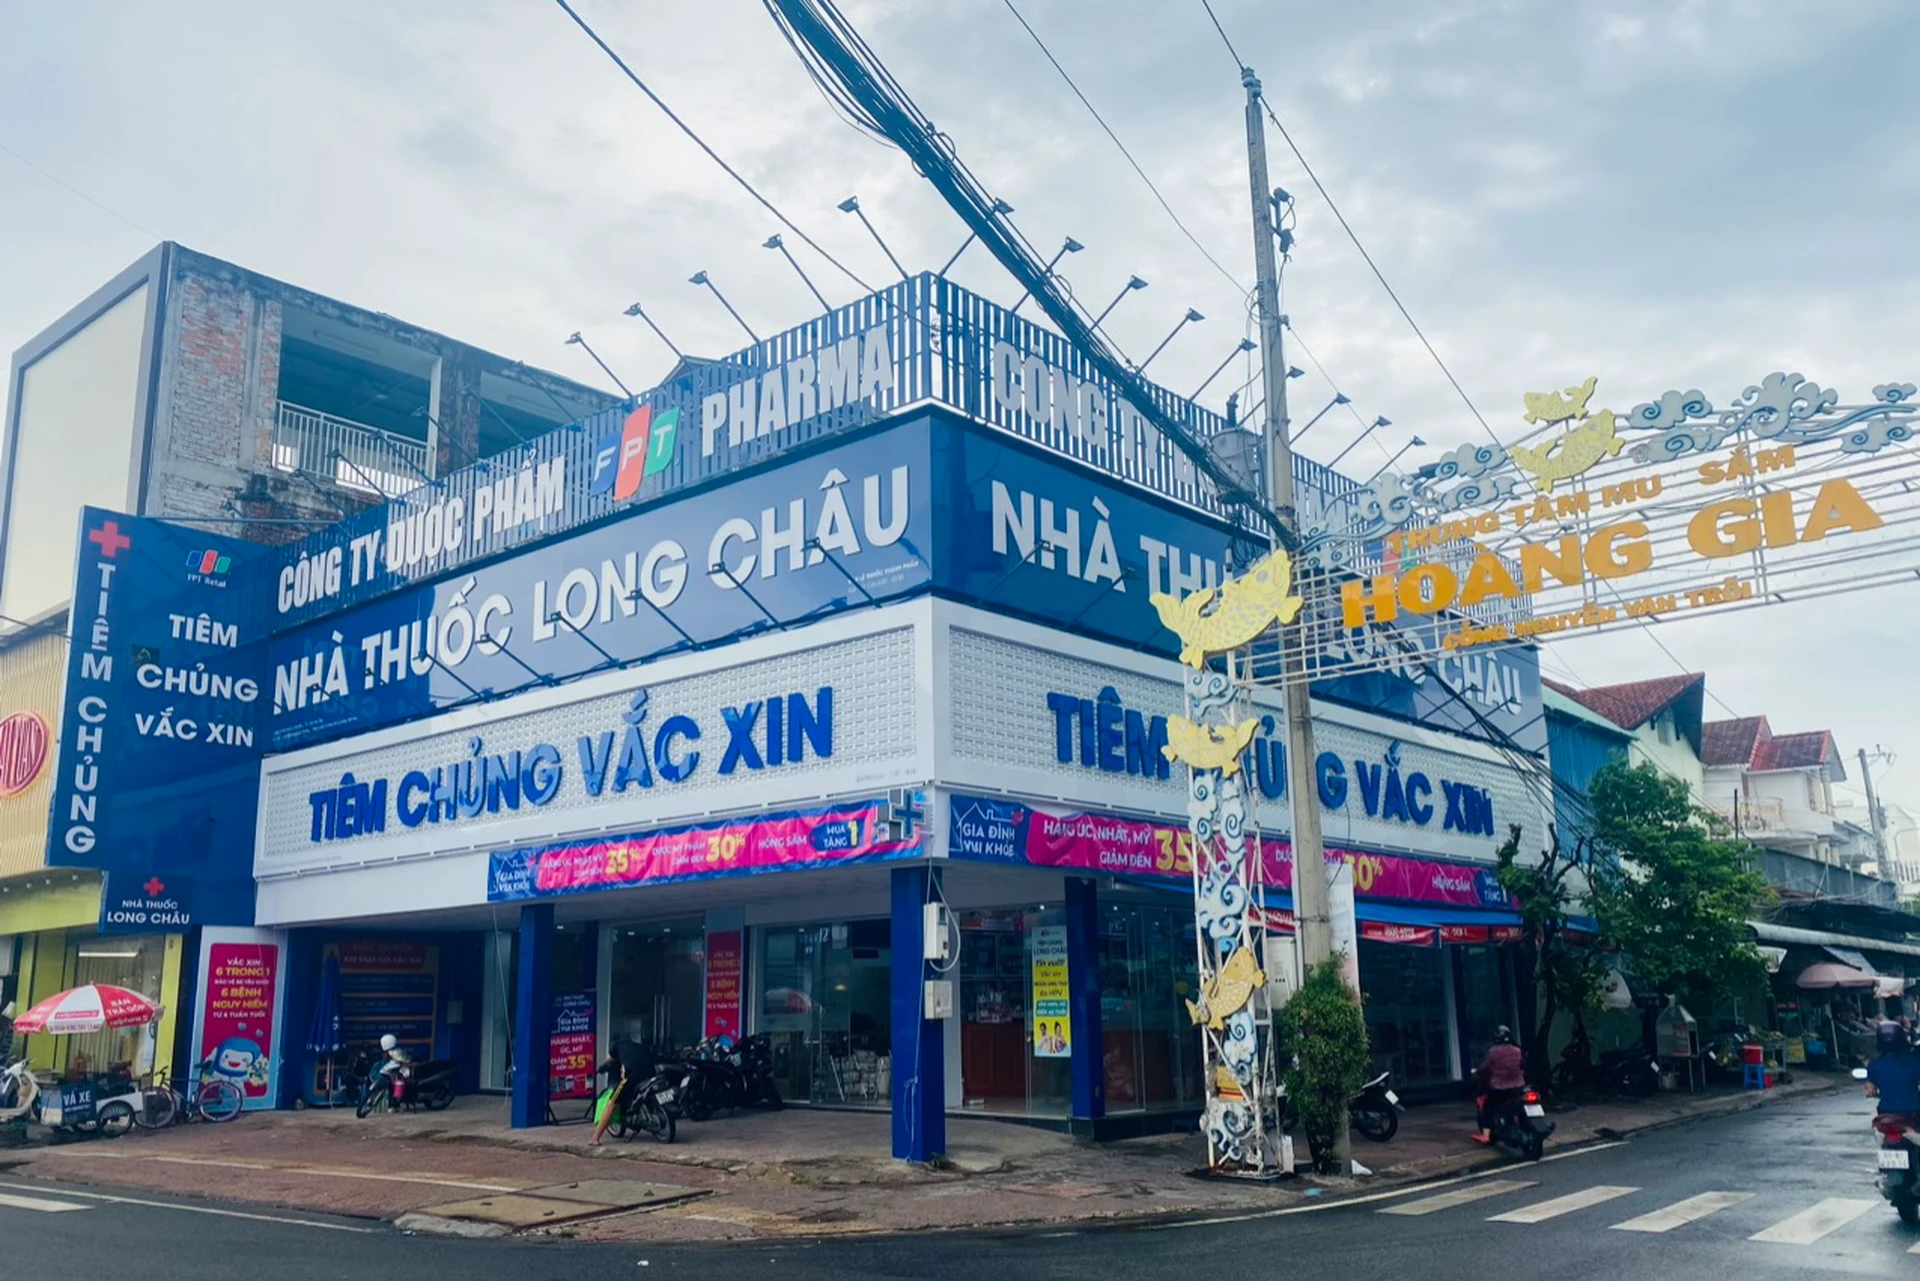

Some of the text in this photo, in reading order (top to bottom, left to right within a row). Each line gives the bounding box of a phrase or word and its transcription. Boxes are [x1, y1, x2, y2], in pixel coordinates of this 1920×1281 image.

[992, 340, 1107, 447] CÔNG
[278, 546, 342, 614] CÔNG
[350, 530, 382, 586] TY
[473, 448, 565, 541] PHẨM
[702, 322, 895, 458] PHARMA
[1508, 491, 1590, 527] TÂM
[991, 479, 1126, 594] NHÀ
[1341, 521, 1653, 629] HOÀNG
[1687, 477, 1886, 559] GIA
[273, 465, 910, 715] NHÀ THUỐC LONG CHÂU
[168, 613, 238, 648] TIÊM
[136, 662, 259, 702] CHỦNG
[1438, 649, 1523, 716] CHÂU
[135, 706, 198, 741] VẮC
[206, 721, 254, 747] XIN
[1047, 685, 1171, 781] TIÊM
[309, 686, 834, 843] TIÊM CHỦNG VẮC XIN
[1355, 739, 1434, 826] VẮC
[1440, 778, 1495, 837] XIN
[823, 836, 848, 850] TẶNG
[826, 825, 846, 836] MUA
[848, 820, 859, 847] 1
[962, 822, 1016, 841] GIA ĐÌNH
[963, 840, 983, 855] VUI
[1154, 829, 1194, 873] 35
[107, 910, 190, 924] LONG CHÂU
[122, 898, 143, 909] NHÀ
[215, 967, 223, 976] 6
[226, 967, 264, 976] TRONG
[213, 1000, 241, 1009] NGUY
[221, 986, 262, 998] 6 BỆNH
[79, 1090, 91, 1102] XE
